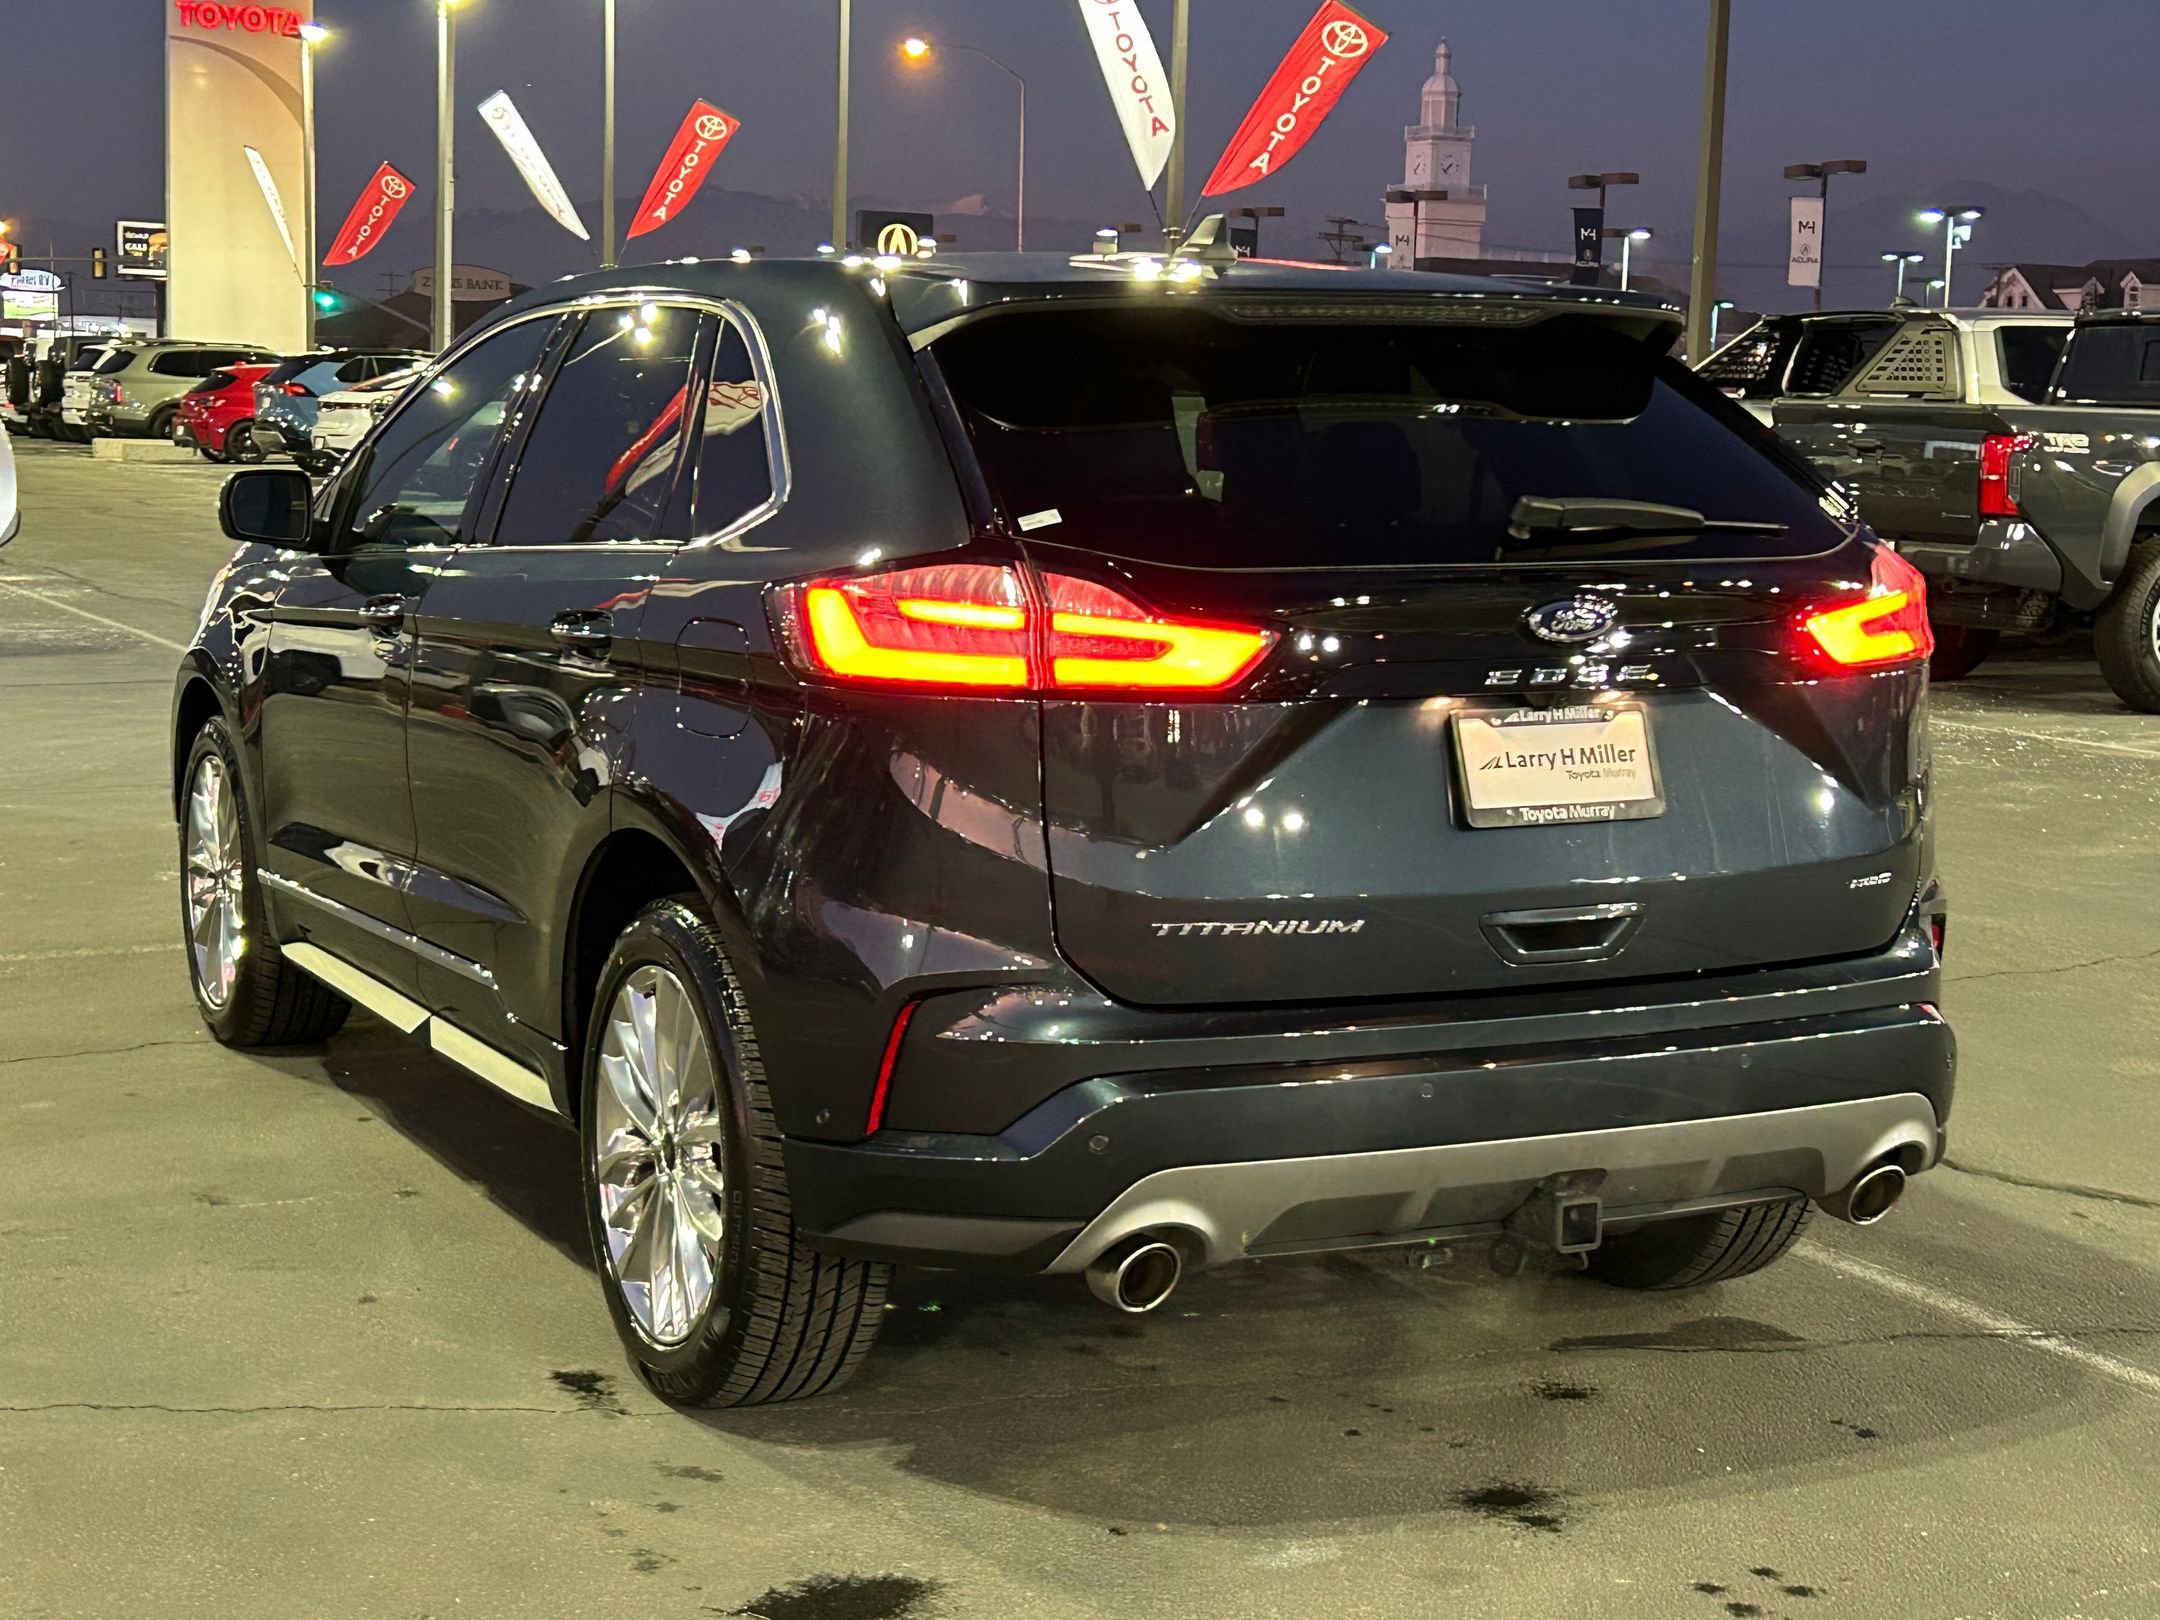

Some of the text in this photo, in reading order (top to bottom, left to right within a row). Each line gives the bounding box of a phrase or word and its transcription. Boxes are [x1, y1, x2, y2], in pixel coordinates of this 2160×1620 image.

[174, 0, 304, 35] TOYOTA
[1108, 11, 1169, 137] TOYOTA
[1250, 56, 1336, 173] TOYOTA
[653, 141, 707, 220] TOYOTA
[347, 195, 391, 257] TOYOTA
[466, 278, 504, 290] BANK
[1485, 663, 1656, 685] EDGE
[1519, 706, 1601, 723] Larry H Miller
[1506, 743, 1636, 771] Larry H Miller
[1566, 767, 1636, 782] Toyota Murray
[1519, 804, 1616, 823] Toyota Murray
[1151, 919, 1366, 937] TITANIUM
